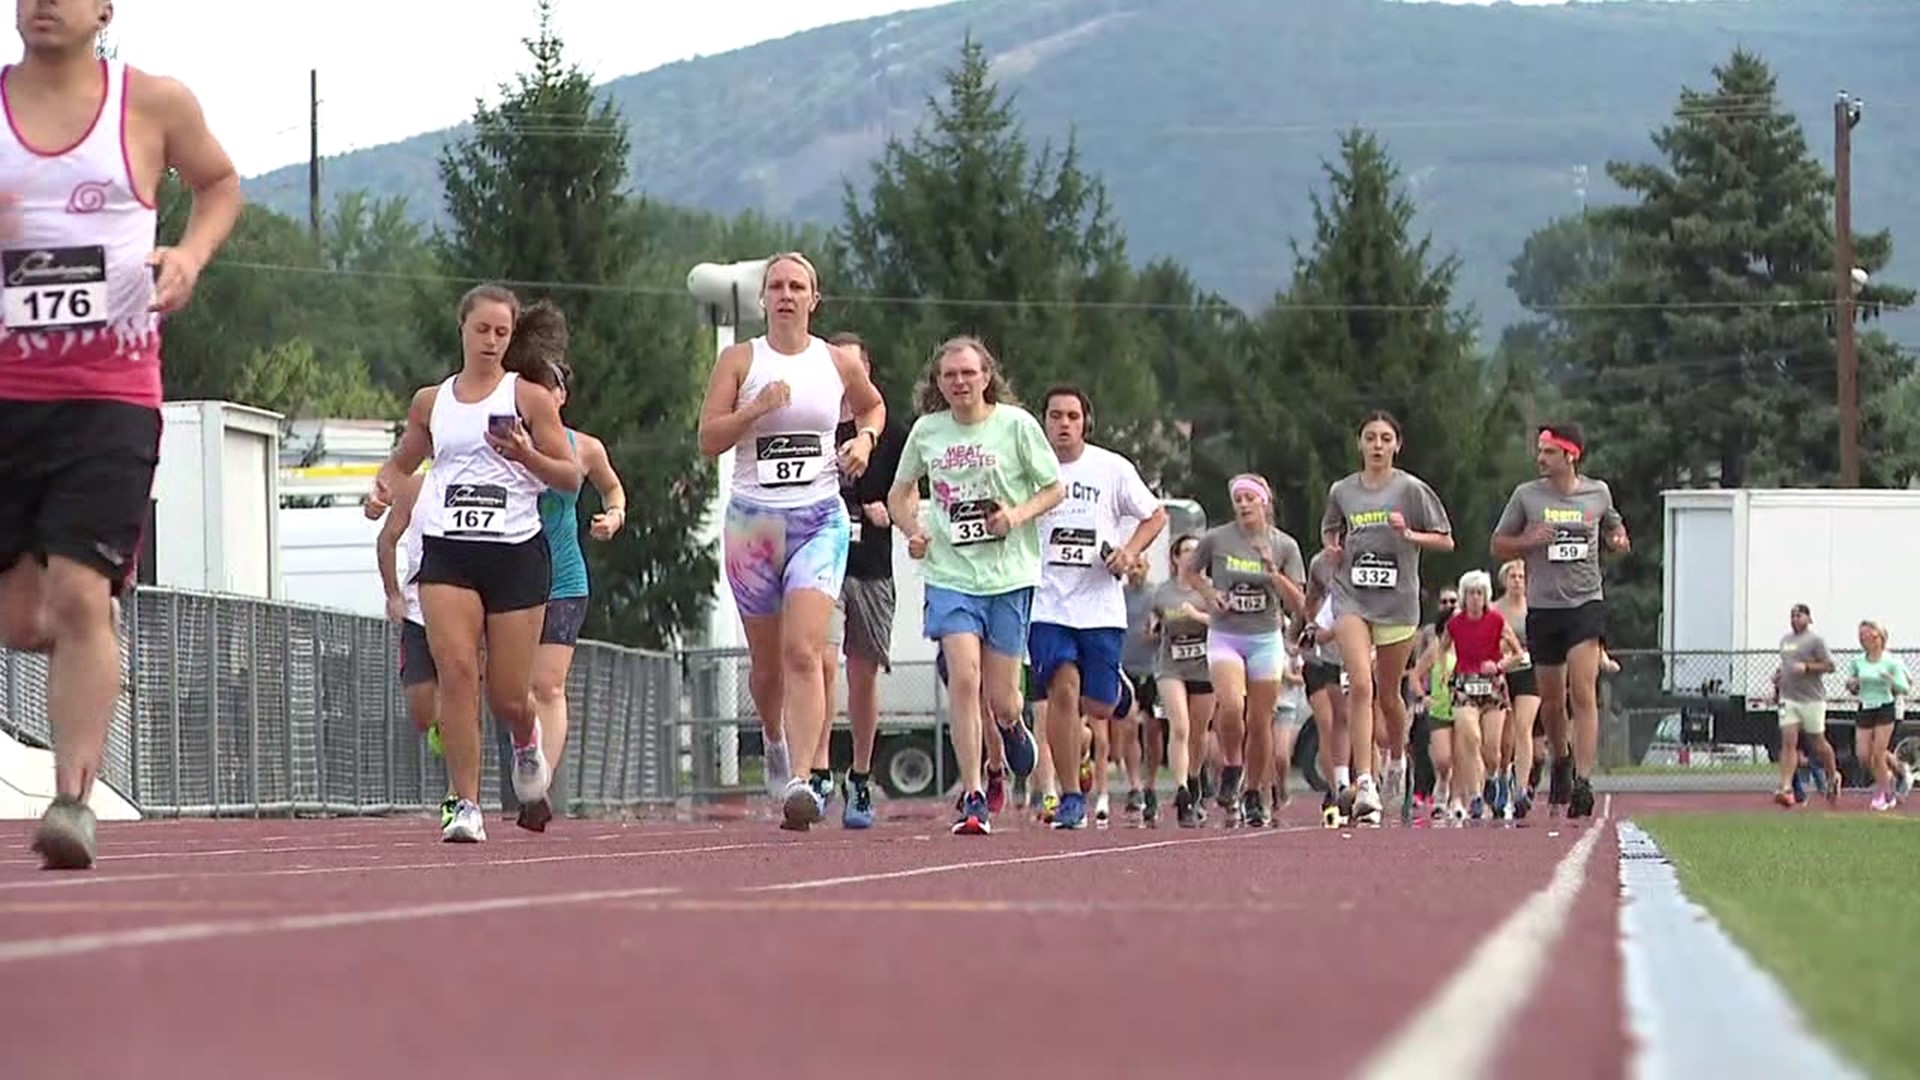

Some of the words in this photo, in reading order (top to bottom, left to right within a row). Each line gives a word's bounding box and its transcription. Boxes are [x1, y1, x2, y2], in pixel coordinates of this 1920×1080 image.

[23, 289, 91, 320] 176
[946, 444, 983, 459] MEAT
[931, 455, 996, 470] PUPPETS
[776, 461, 806, 480] 87
[1072, 481, 1100, 504] CITY
[452, 510, 495, 528] 167
[958, 522, 985, 540] 33
[1061, 546, 1083, 561] 54
[1559, 546, 1578, 558] 59
[1358, 569, 1390, 584] 332
[1237, 597, 1262, 610] 162
